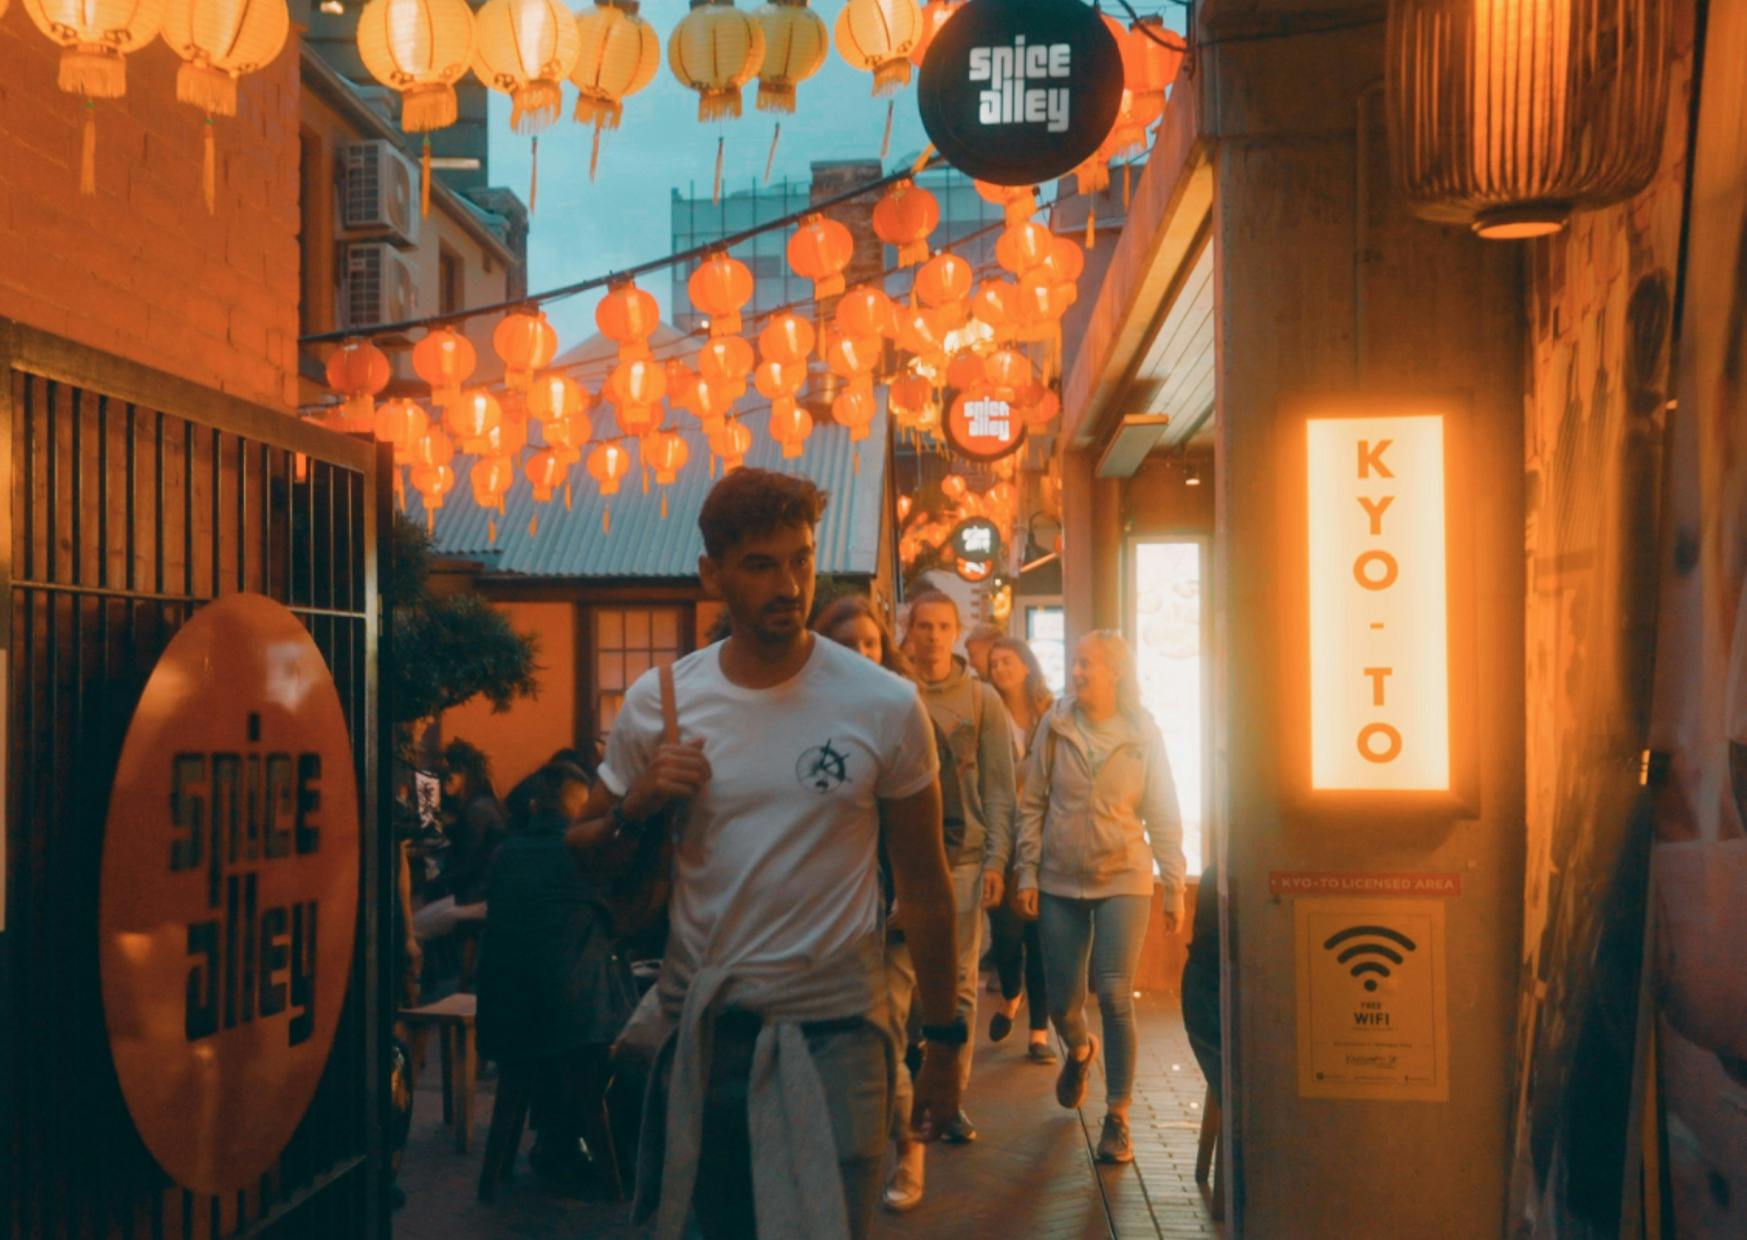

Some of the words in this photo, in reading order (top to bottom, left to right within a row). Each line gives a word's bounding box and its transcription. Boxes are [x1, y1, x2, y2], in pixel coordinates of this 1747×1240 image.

[969, 35, 1070, 90] spice
[979, 79, 1070, 133] alley
[169, 712, 322, 908] spice
[1281, 877, 1339, 889] KYO-TO
[1342, 877, 1411, 889] LICENSED
[1414, 878, 1455, 890] AREA
[185, 871, 318, 1048] alley
[1353, 1012, 1390, 1026] WIFI
